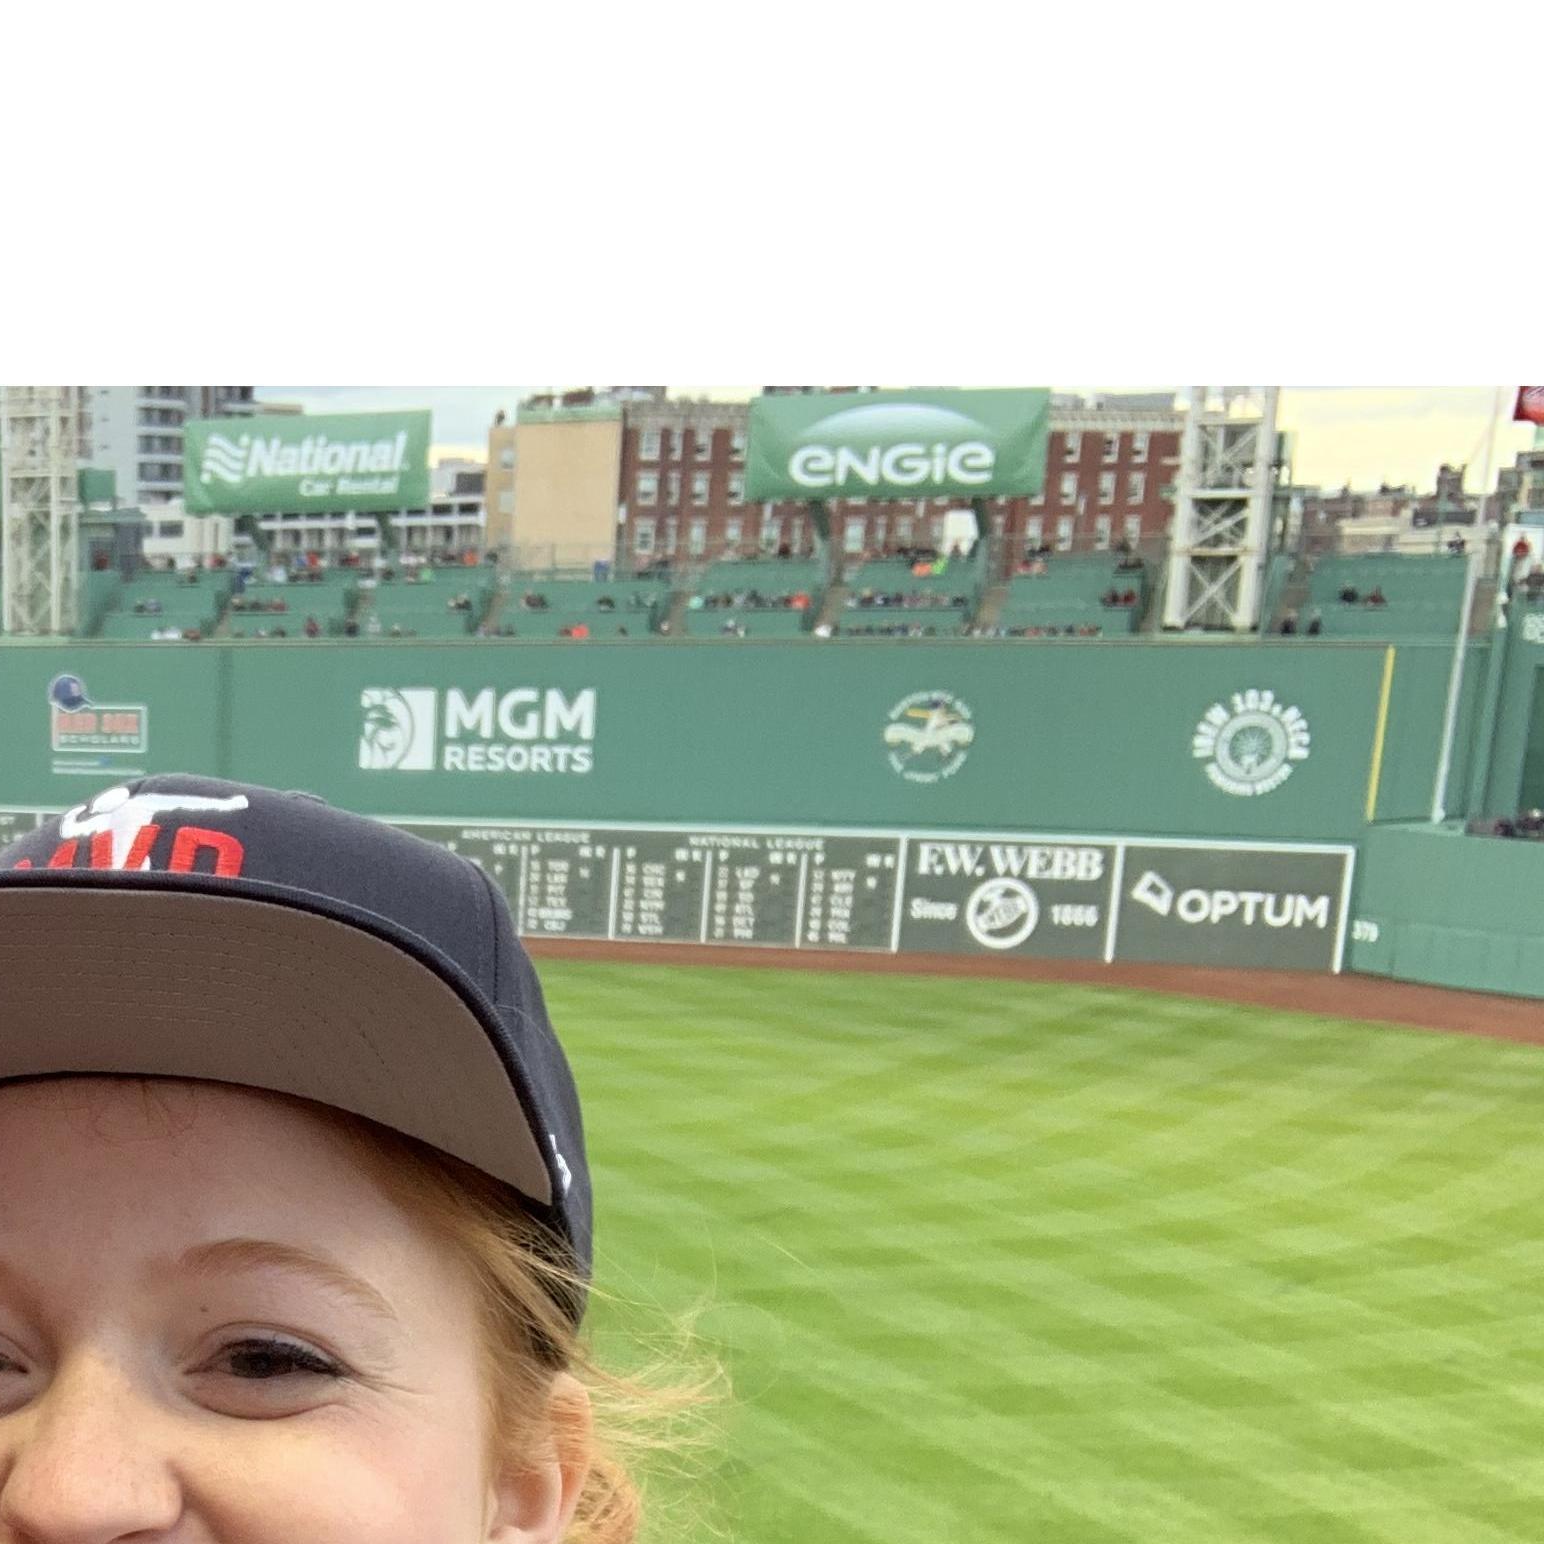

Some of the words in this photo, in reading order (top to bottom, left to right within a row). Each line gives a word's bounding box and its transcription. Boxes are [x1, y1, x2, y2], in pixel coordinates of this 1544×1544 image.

[246, 430, 408, 477] National
[445, 687, 596, 740] MGM
[444, 744, 594, 773] RESORTS
[989, 844, 1104, 881] WEBB
[910, 898, 958, 920] Since
[1176, 889, 1331, 929] OPTUM
